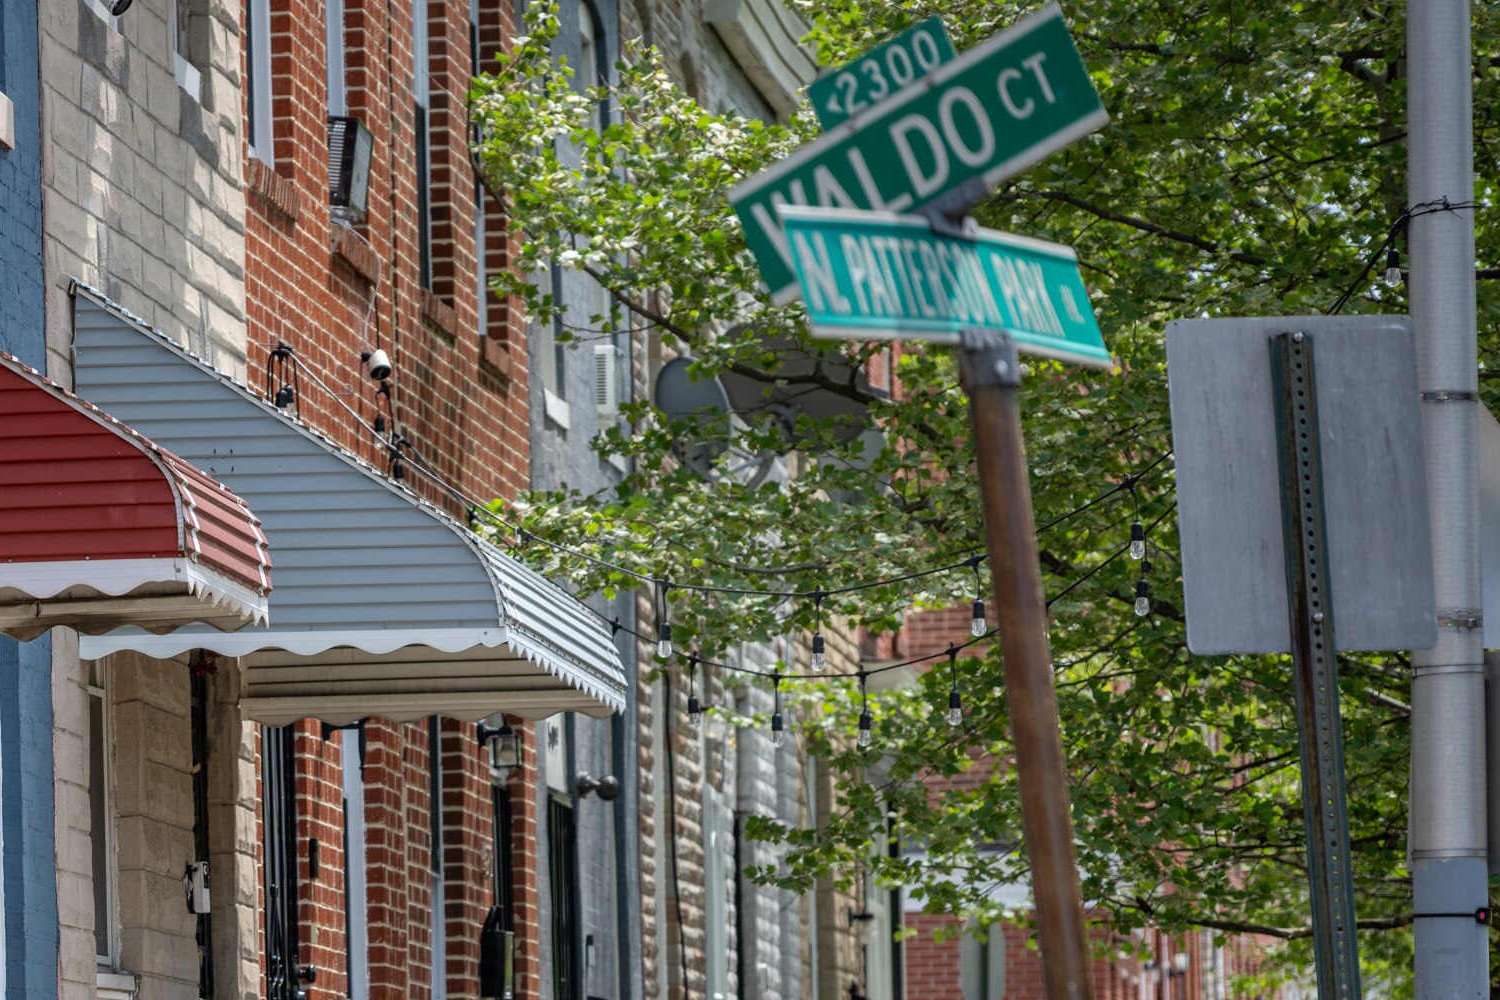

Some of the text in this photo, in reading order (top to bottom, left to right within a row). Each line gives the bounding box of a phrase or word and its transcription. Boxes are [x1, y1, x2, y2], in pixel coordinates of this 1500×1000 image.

[835, 29, 940, 115] 2300
[997, 51, 1057, 121] CT
[839, 233, 1003, 325] PATTERSON
[989, 252, 1066, 338] PARK
